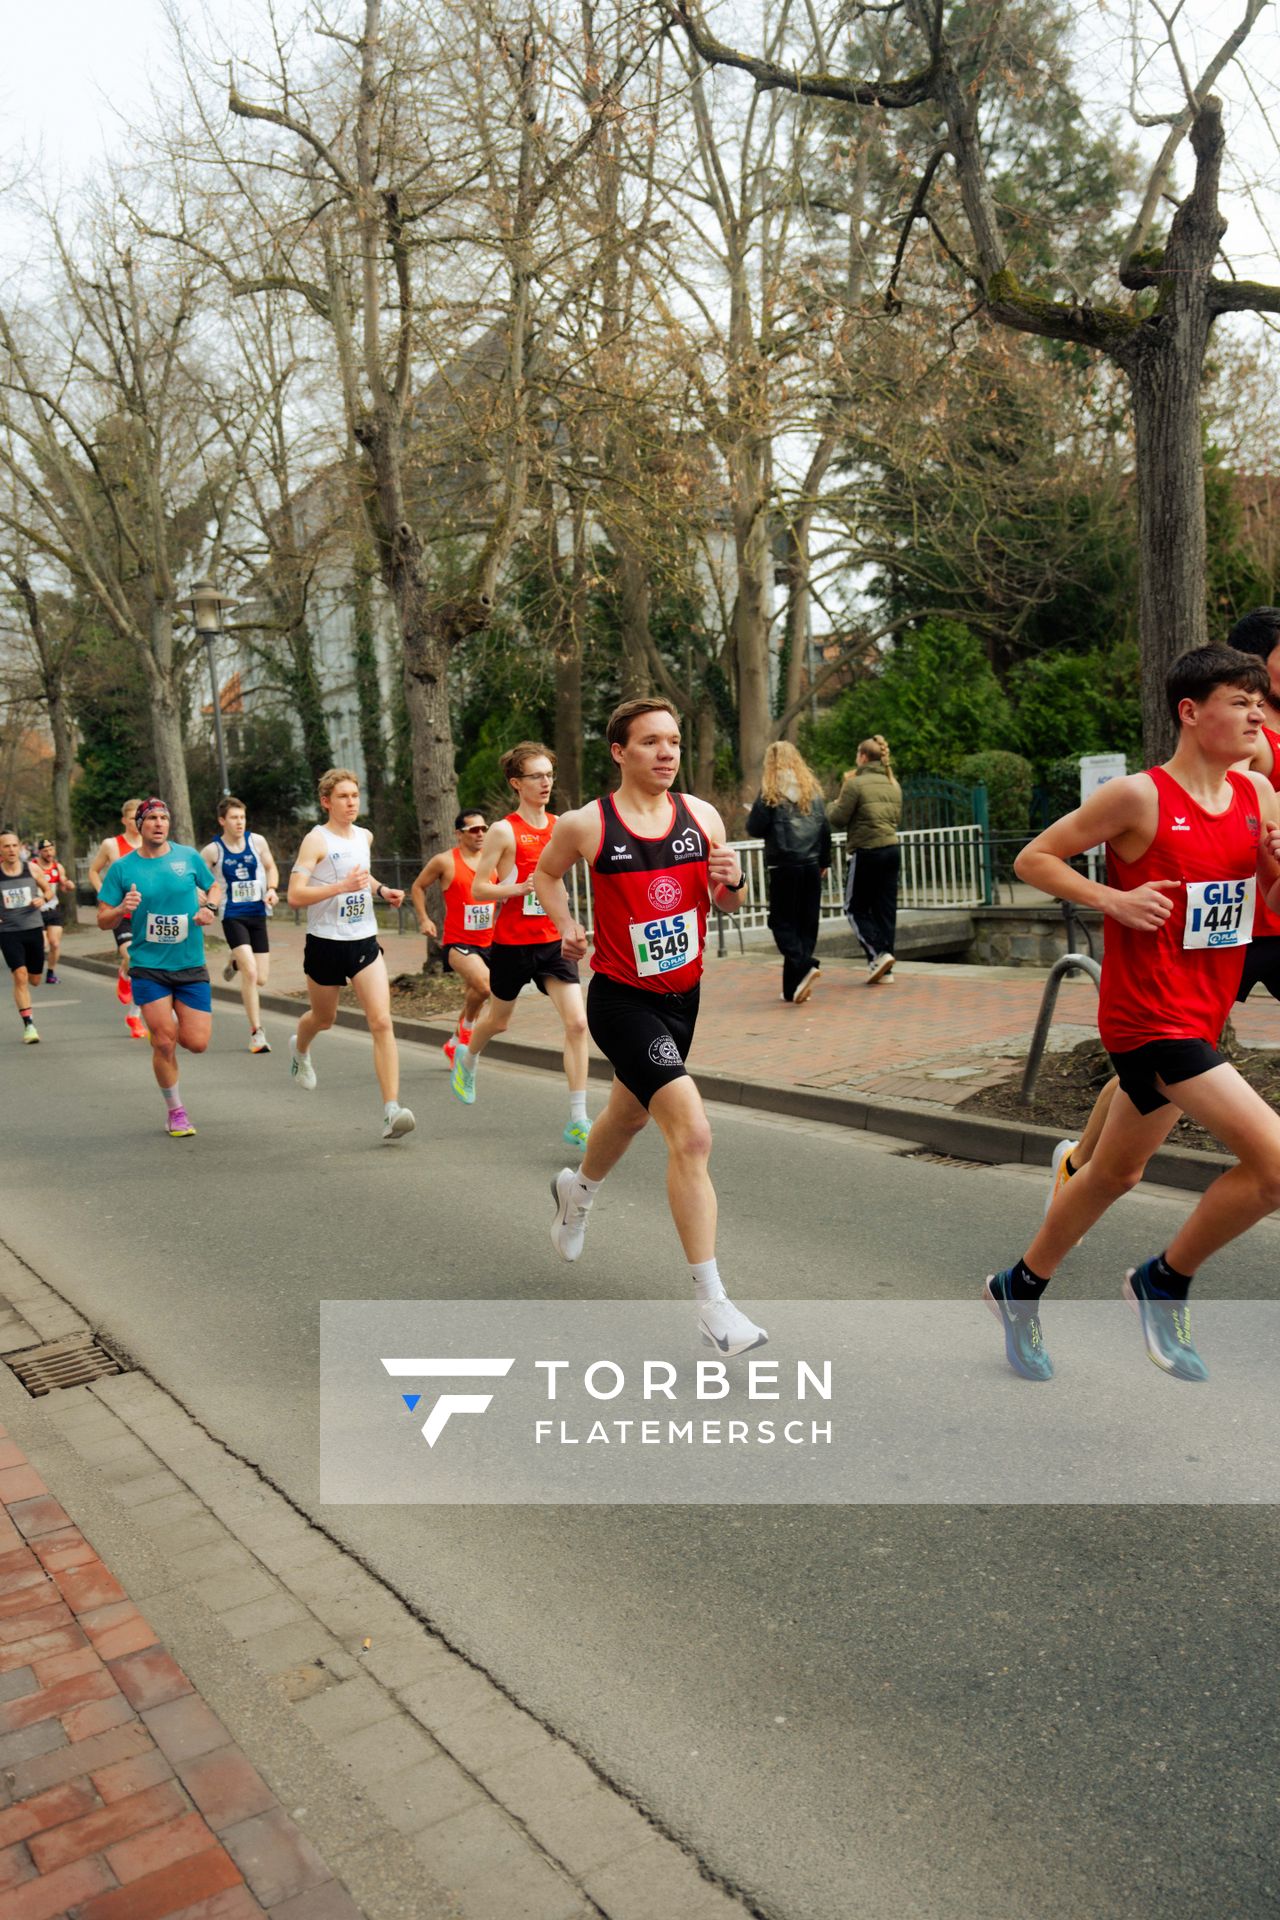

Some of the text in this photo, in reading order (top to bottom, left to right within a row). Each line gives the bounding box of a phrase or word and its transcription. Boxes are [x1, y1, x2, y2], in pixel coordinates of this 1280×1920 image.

[672, 838, 695, 854] OS
[611, 853, 633, 861] erima
[346, 894, 365, 905] GLS
[1203, 882, 1245, 905] GLS
[346, 904, 365, 917] 352
[471, 906, 490, 914] GLS
[155, 916, 178, 925] GLS
[473, 914, 490, 924] 189
[1204, 904, 1243, 931] 441
[155, 925, 180, 936] 358
[644, 916, 685, 940] GLS
[649, 932, 689, 960] 549
